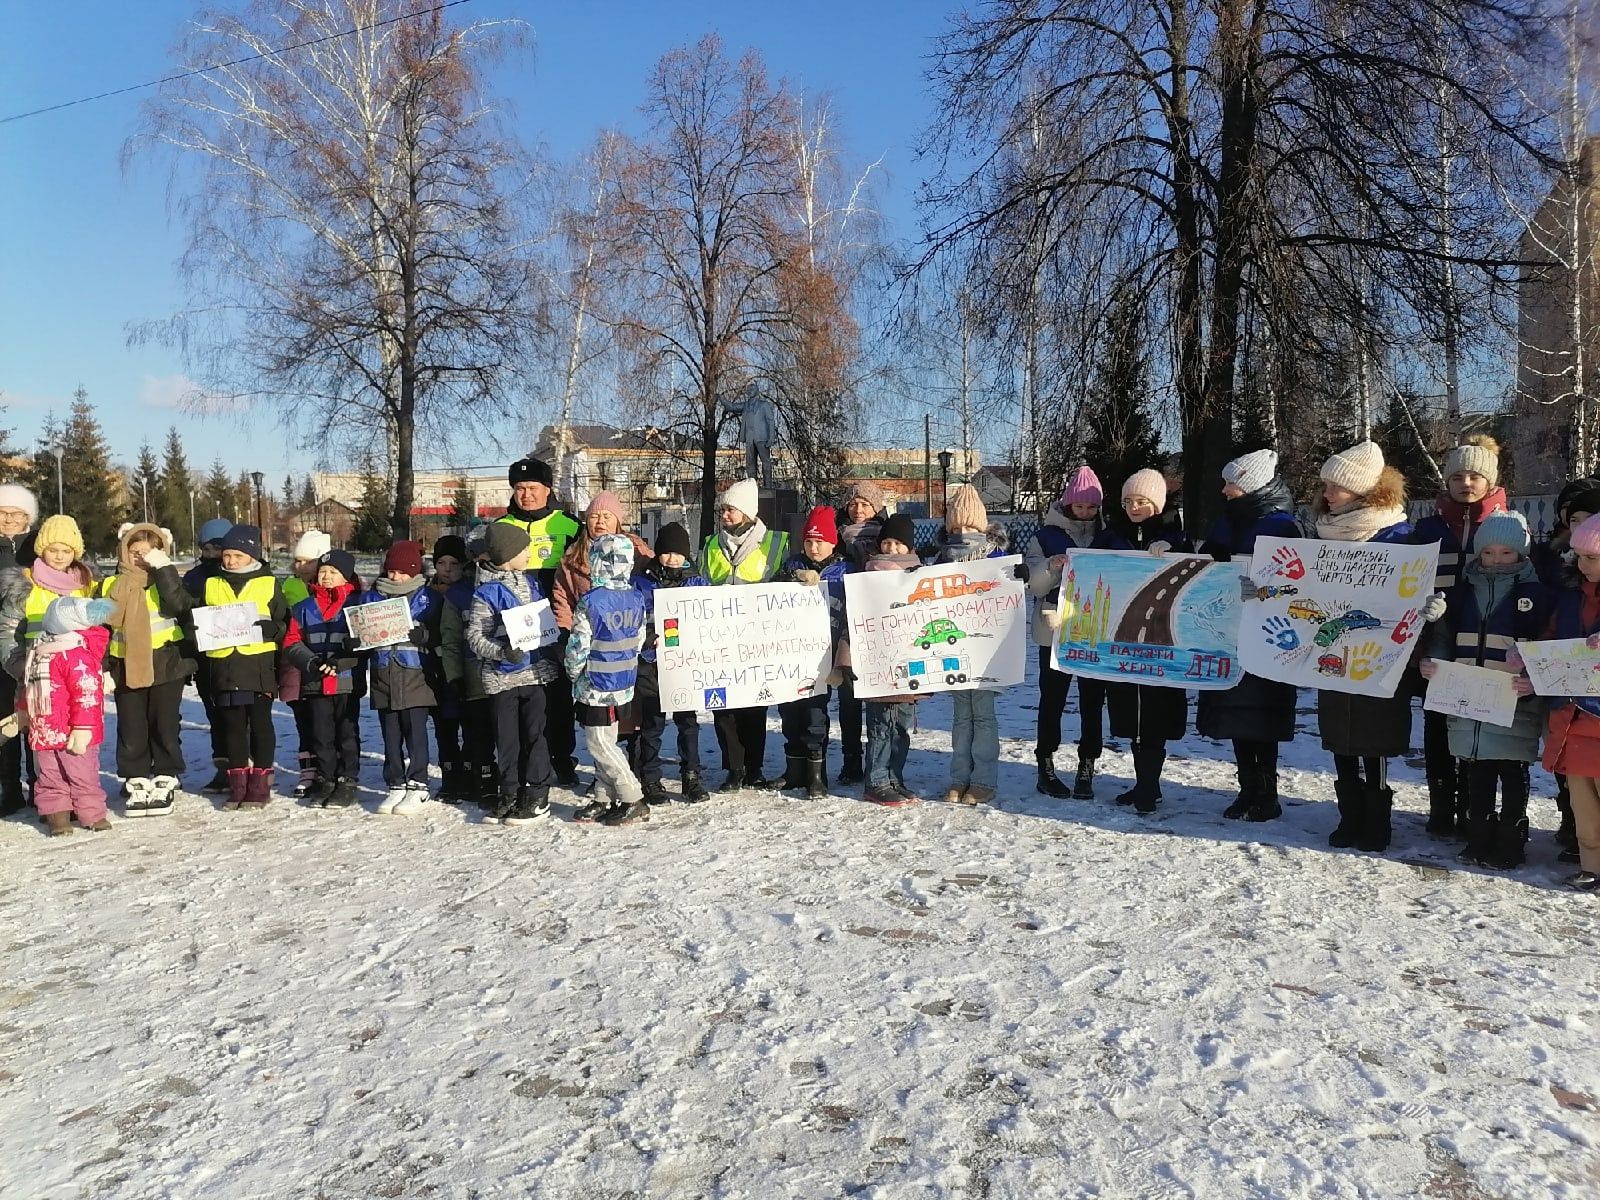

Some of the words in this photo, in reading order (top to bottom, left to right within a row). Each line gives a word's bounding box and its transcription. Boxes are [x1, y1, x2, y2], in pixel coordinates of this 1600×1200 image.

[1310, 558, 1339, 572] ДЕНЬ
[1342, 561, 1396, 575] ПАМЯТИ
[1317, 571, 1353, 585] ЖЕРТВ
[1354, 574, 1388, 588] ДТП
[666, 598, 714, 622] ЧТОБ
[721, 597, 746, 617] НЕ
[757, 589, 827, 613] ПЛАКАЛИ
[853, 613, 875, 634] НЕ
[881, 607, 939, 631] ГОНИТЕ
[946, 593, 1023, 619] ВОДИТЕЛИ
[698, 619, 796, 644] РОДИТЕЛИ
[964, 613, 1008, 632] ТОЖЕ
[664, 647, 730, 671] БУДЬТЕ
[1065, 648, 1100, 663] ДЕНЬ
[1110, 645, 1174, 660] ПАМЯТИ
[1119, 661, 1166, 677] ЖЕРТВ
[1184, 654, 1231, 679] ДТП
